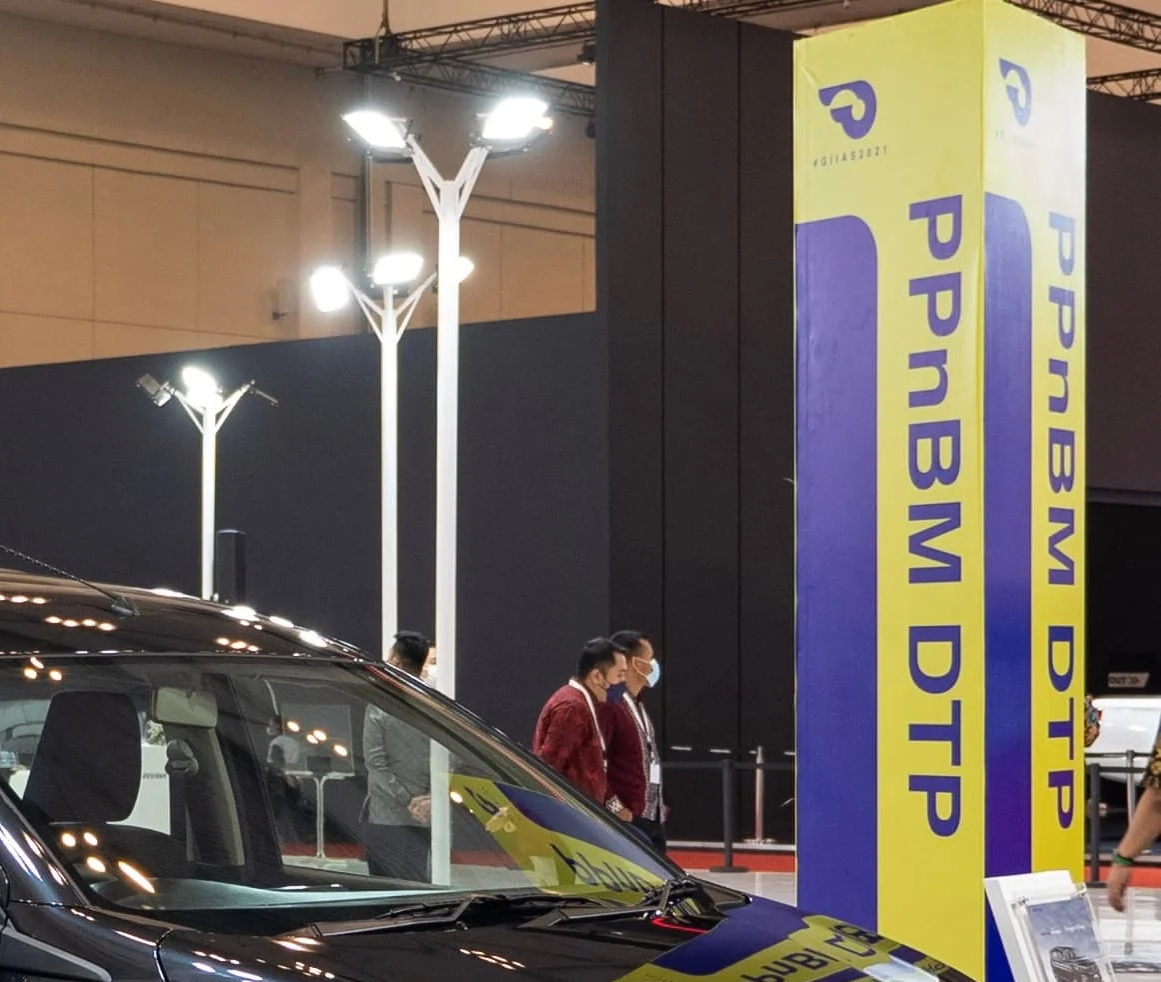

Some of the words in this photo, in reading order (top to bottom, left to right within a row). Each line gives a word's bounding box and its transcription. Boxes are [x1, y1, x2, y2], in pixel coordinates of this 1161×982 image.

[908, 193, 962, 584] PPnBM
[1047, 211, 1076, 586] PPnBM
[908, 625, 961, 837] DTP
[1047, 626, 1075, 830] DTP
